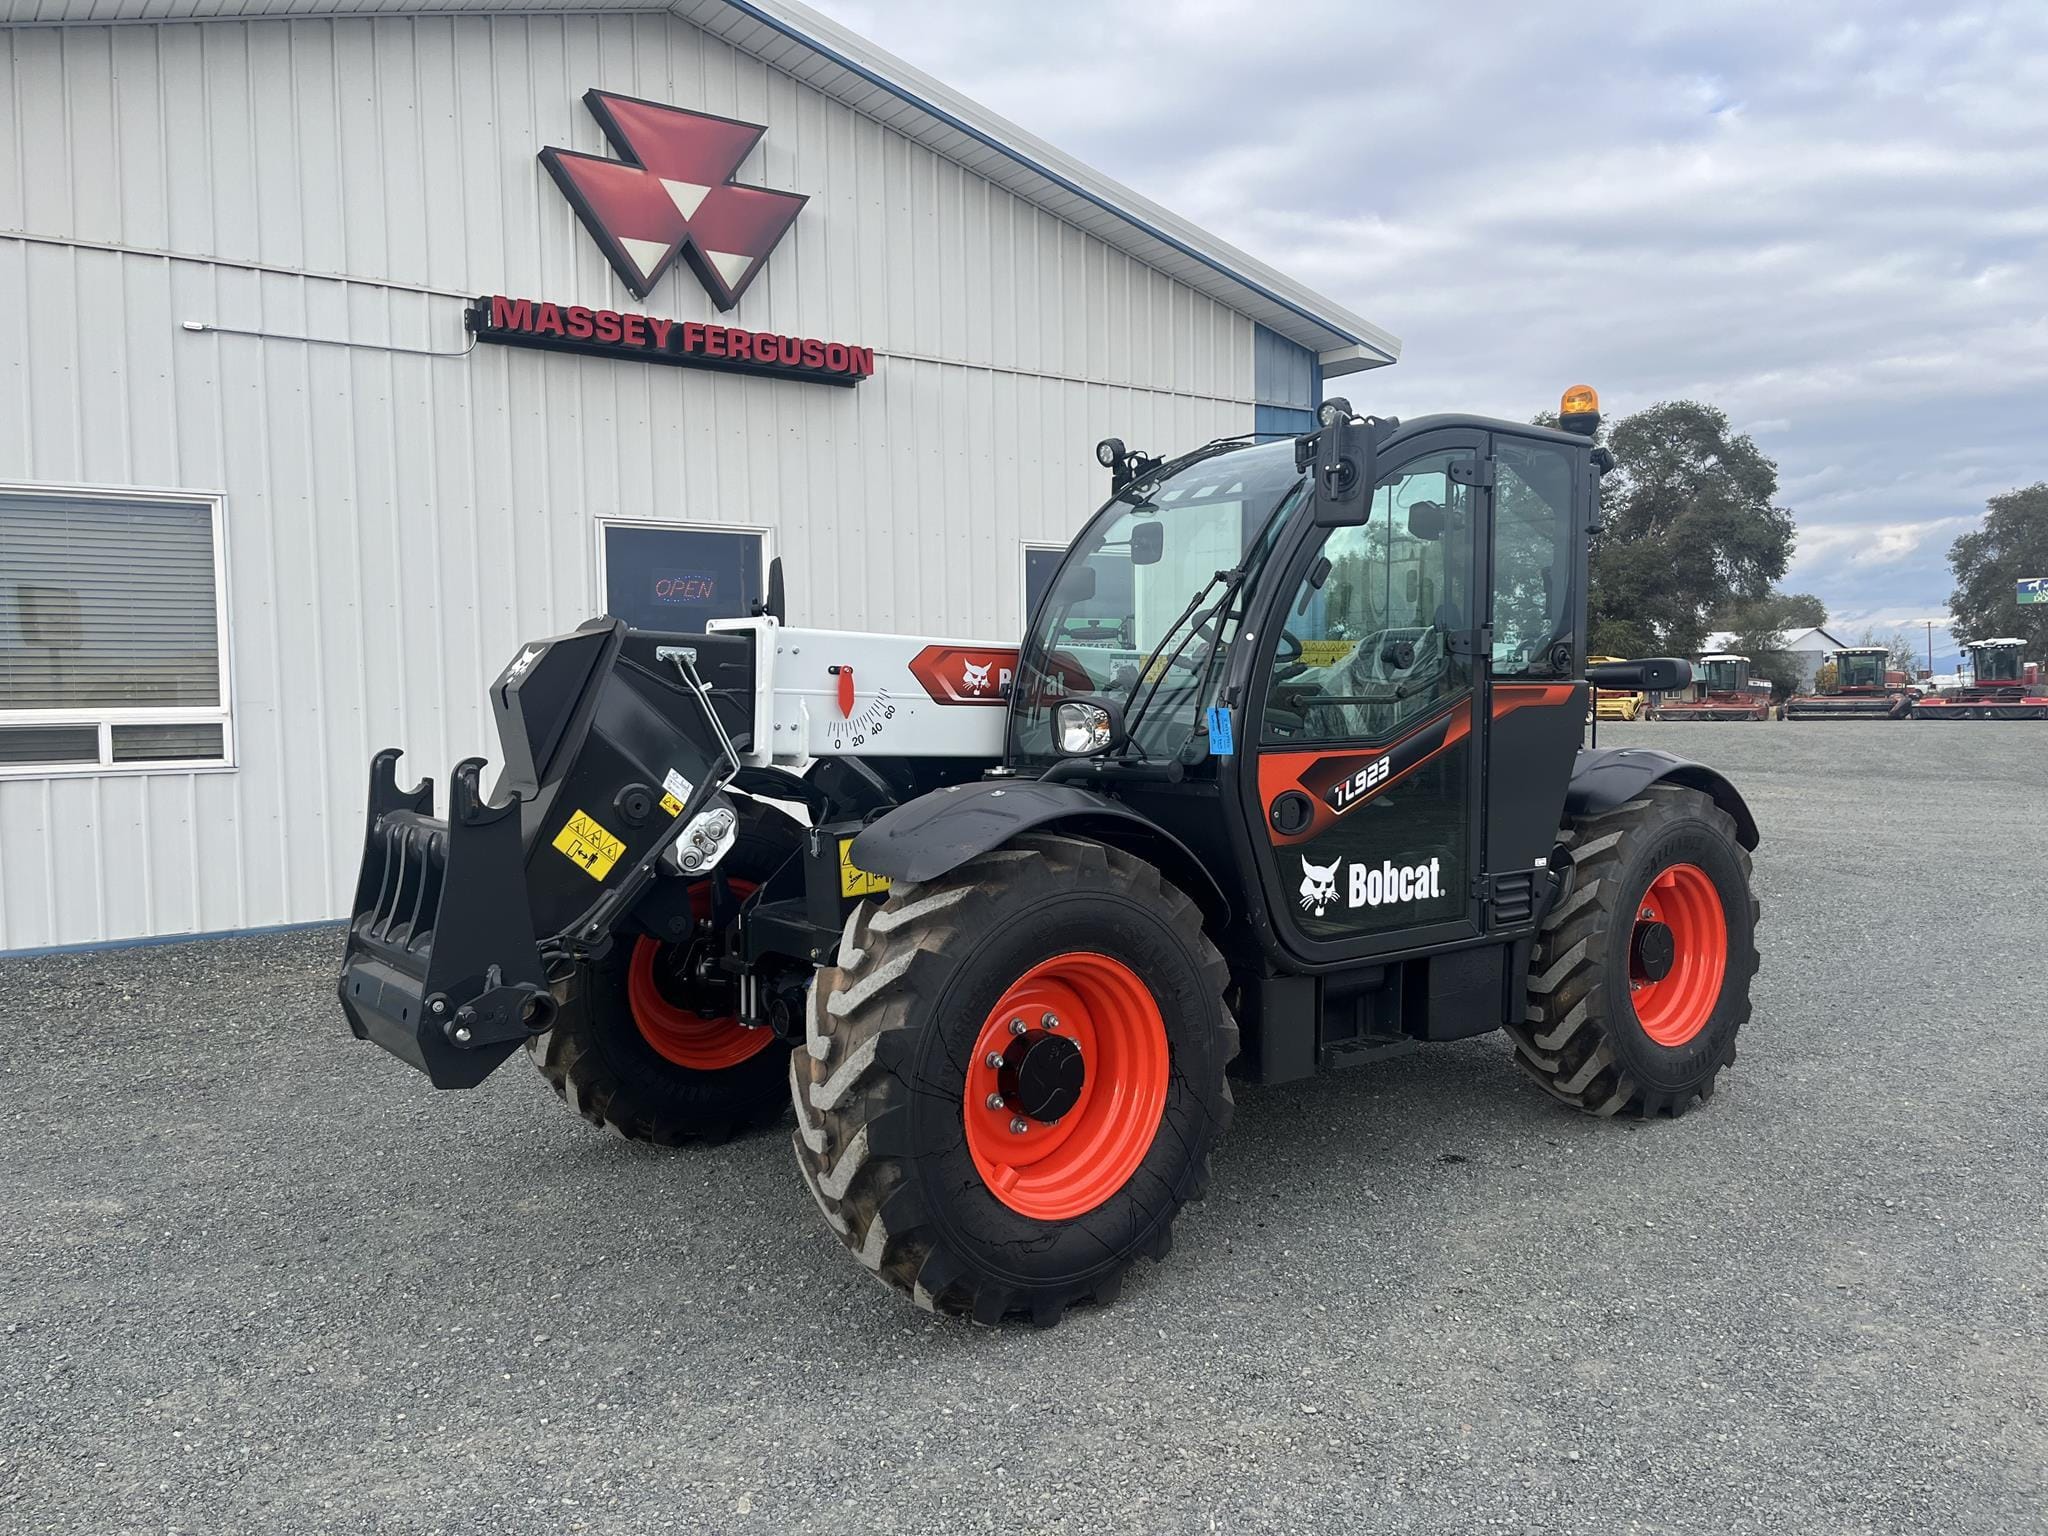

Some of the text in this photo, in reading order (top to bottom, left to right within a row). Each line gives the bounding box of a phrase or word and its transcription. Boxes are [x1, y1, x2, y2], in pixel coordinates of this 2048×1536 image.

[491, 294, 874, 377] MASSEY FERGUSON
[655, 579, 714, 598] OPEN
[999, 668, 1064, 697] Bat
[834, 705, 896, 750] 0 20 40 60
[1334, 755, 1390, 806] TL923
[1348, 857, 1440, 908] Bobcat
